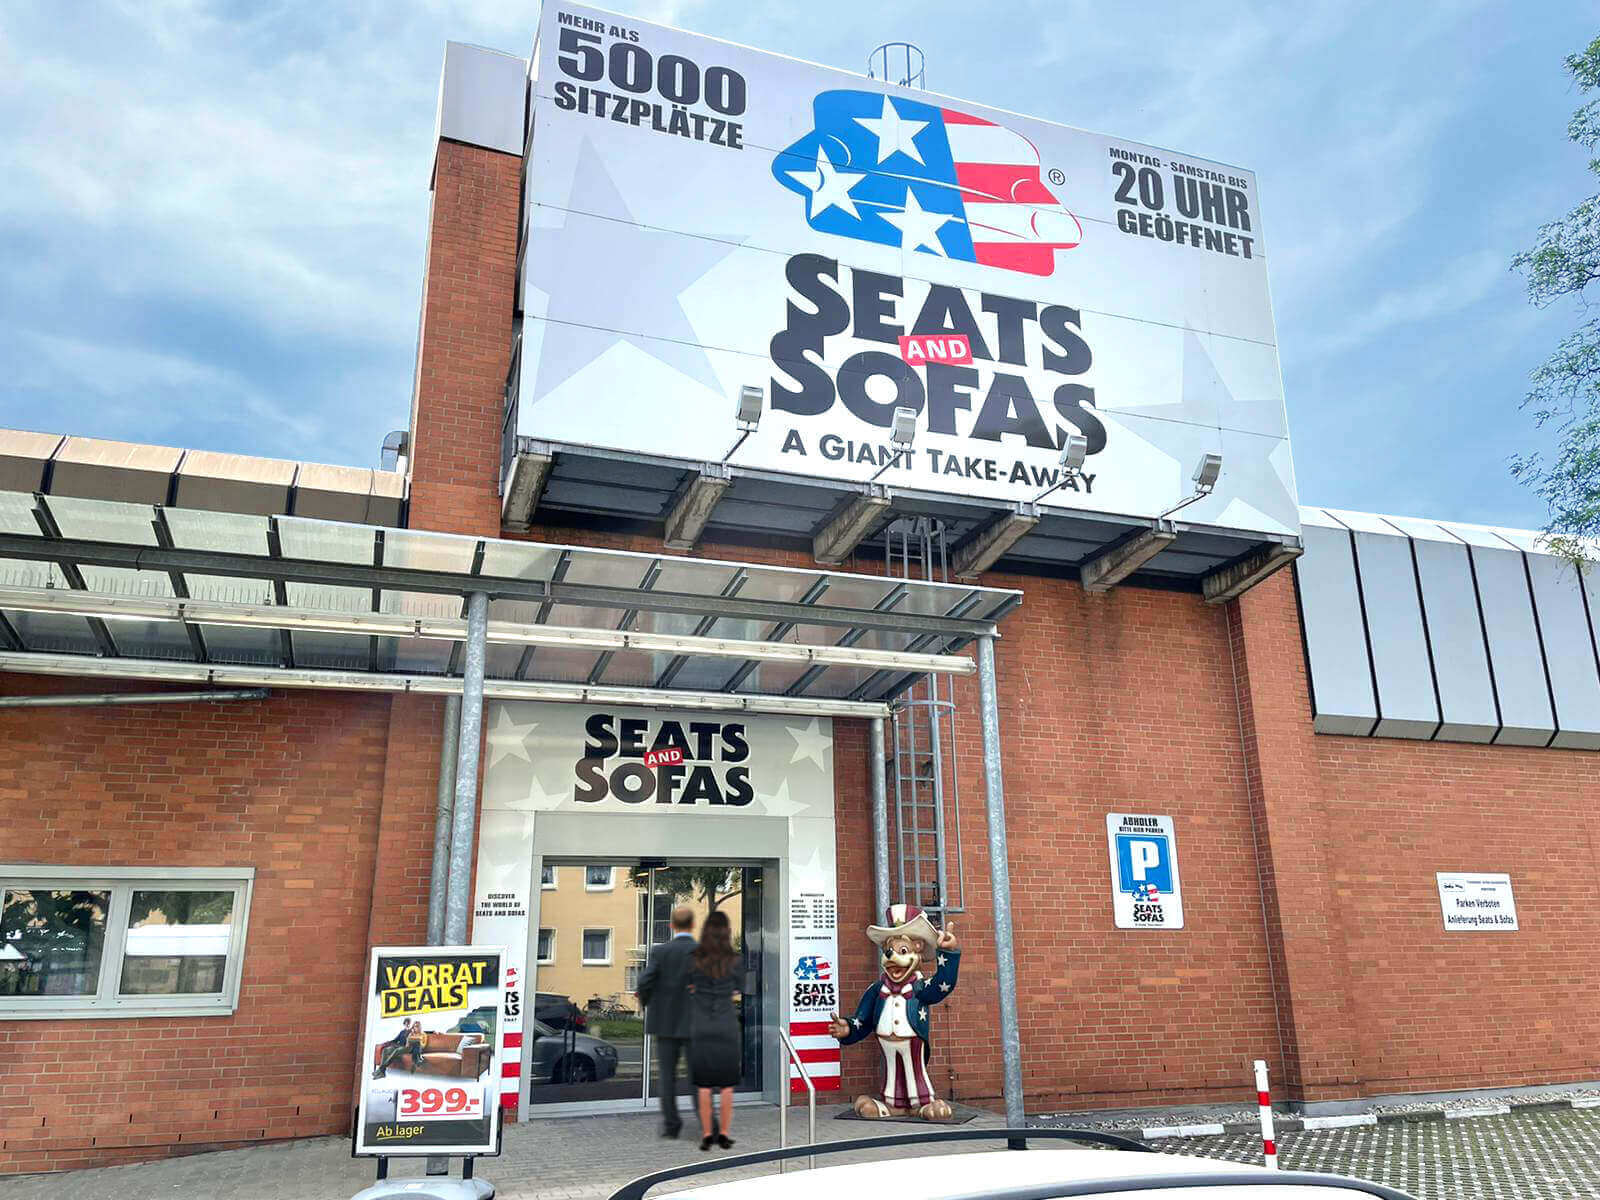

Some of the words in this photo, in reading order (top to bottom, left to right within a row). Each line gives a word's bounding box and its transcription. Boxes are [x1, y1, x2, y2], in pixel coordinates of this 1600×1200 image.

[558, 12, 605, 34] MEHR
[610, 25, 640, 43] ALS
[558, 27, 746, 117] 5000
[554, 81, 743, 150] SITZPLÄTZE
[1109, 147, 1160, 168] MONTAG
[1170, 161, 1226, 184] SAMSTAG
[1228, 176, 1248, 189] BIS
[1112, 161, 1164, 211] 20
[1173, 175, 1251, 232] UHR
[1117, 208, 1254, 259] GEÖFFNET
[785, 253, 1093, 375] SEATS
[907, 338, 967, 361] AND
[770, 330, 1107, 455] SOFAS
[781, 429, 807, 456] A
[819, 434, 915, 470] GIANT
[585, 714, 749, 762] SEATS
[647, 750, 680, 765] AND
[574, 757, 754, 806] SOFAS
[1123, 816, 1158, 827] ABHOLER
[1130, 840, 1160, 880] P
[1133, 912, 1164, 922] SOFAS
[1134, 904, 1163, 913] SEATS
[386, 961, 487, 988] VORRAT
[795, 983, 834, 994] SEATS
[384, 985, 464, 1014] DEALS
[793, 994, 836, 1006] SOFAS
[401, 1088, 480, 1113] 399.-
[376, 1126, 393, 1137] Ab
[396, 1125, 424, 1138] lager
